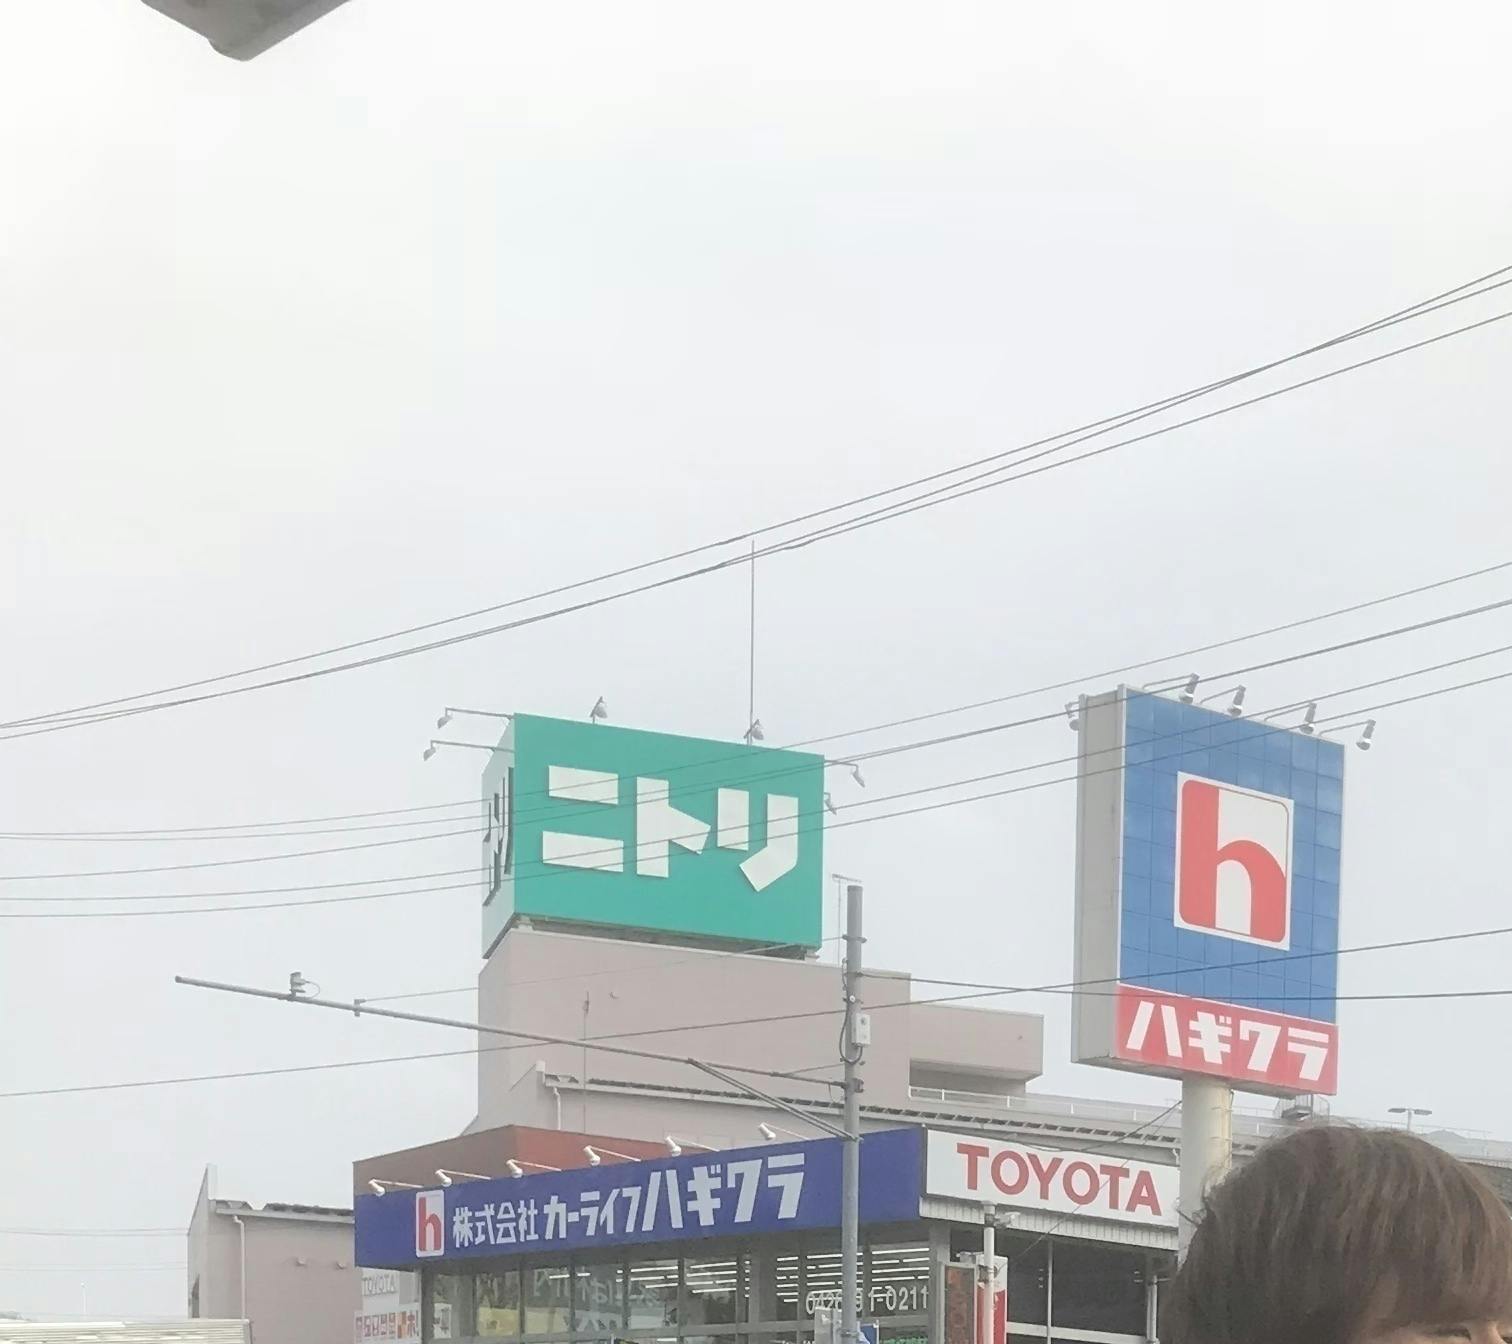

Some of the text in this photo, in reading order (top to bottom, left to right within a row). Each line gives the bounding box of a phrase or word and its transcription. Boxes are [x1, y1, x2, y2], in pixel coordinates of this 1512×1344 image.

[540, 765, 799, 893] ニトリ
[1126, 1000, 1330, 1081] ハギワラ
[956, 1143, 1163, 1217] TOYOTA
